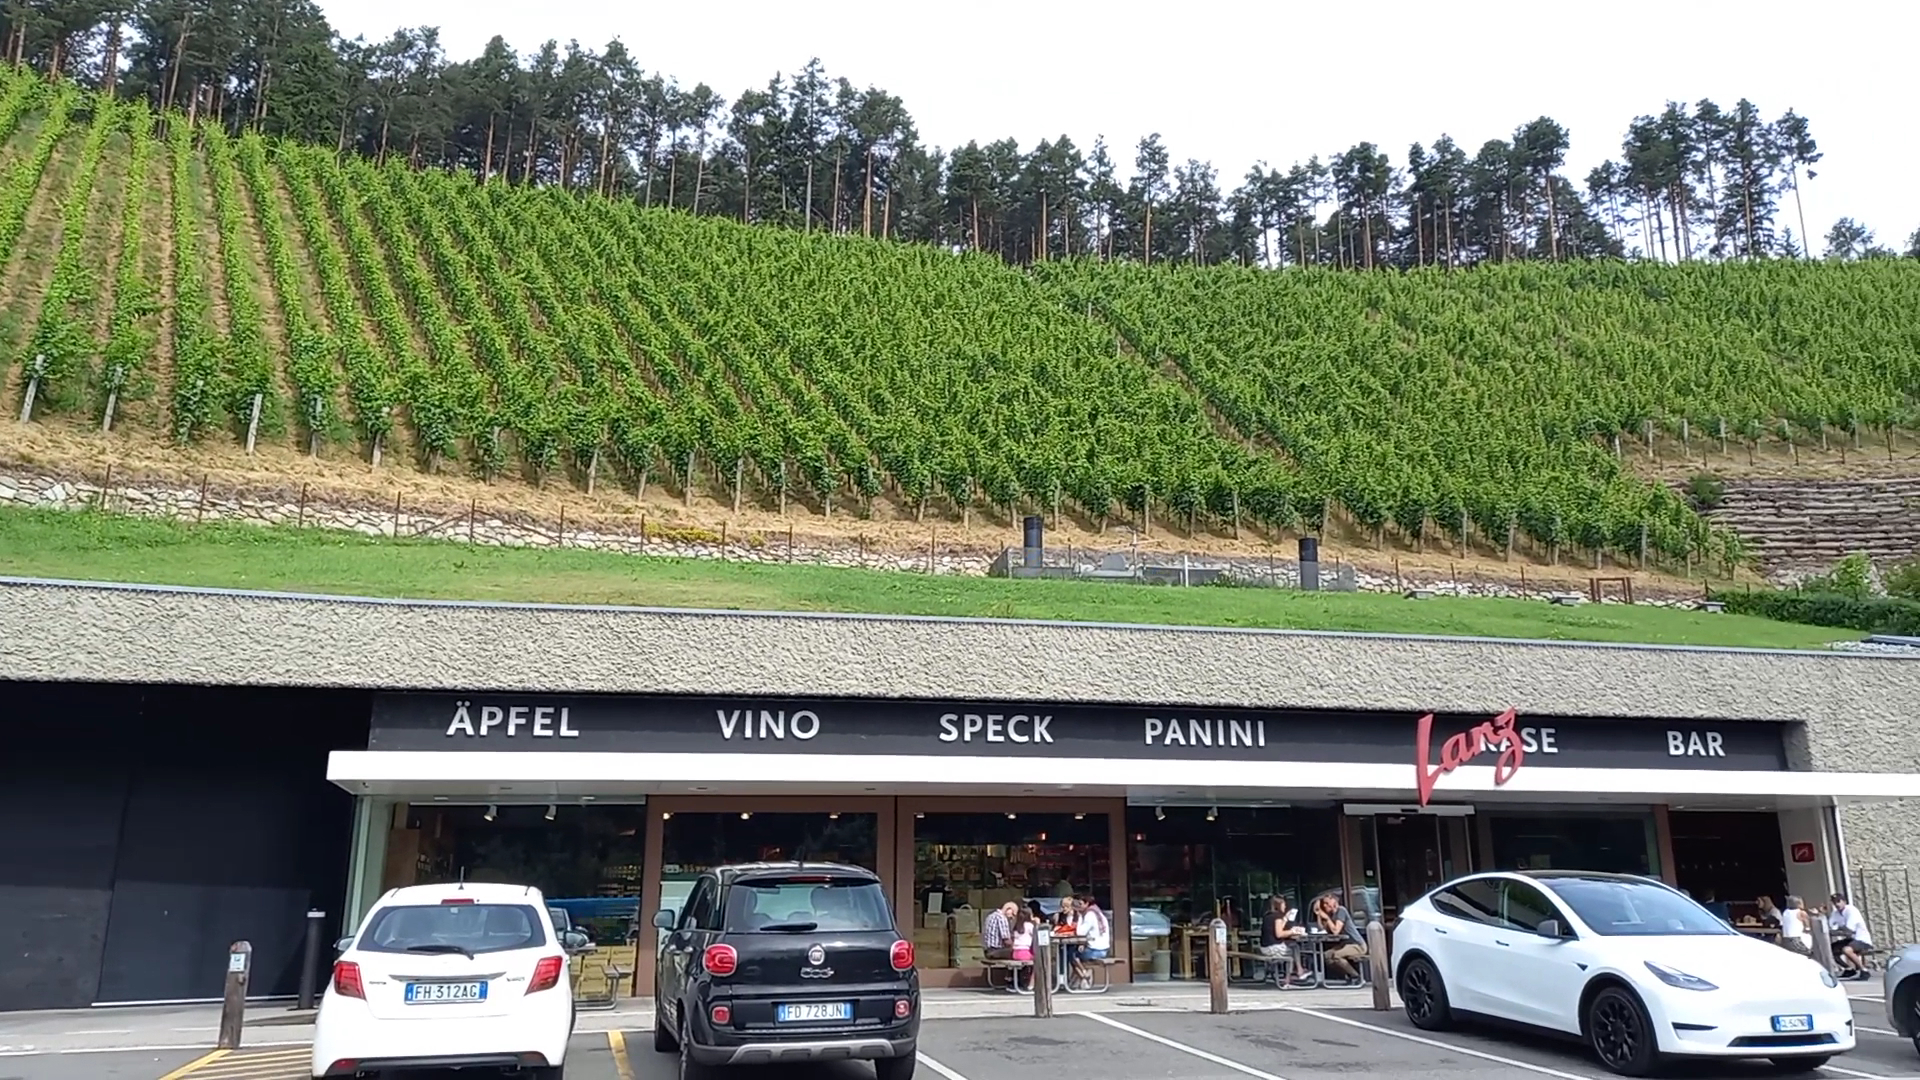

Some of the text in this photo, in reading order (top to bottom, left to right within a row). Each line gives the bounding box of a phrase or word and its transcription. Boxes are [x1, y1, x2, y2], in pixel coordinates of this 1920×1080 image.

[446, 701, 580, 737] ÄPFEL
[716, 710, 821, 741] VINO
[939, 713, 1054, 744] SPECK
[1145, 718, 1267, 747] PANINI
[1667, 731, 1726, 758] BAR
[1416, 706, 1525, 807] Lanz
[414, 984, 478, 999] FH 312AG
[787, 1004, 843, 1018] FD 728JN
